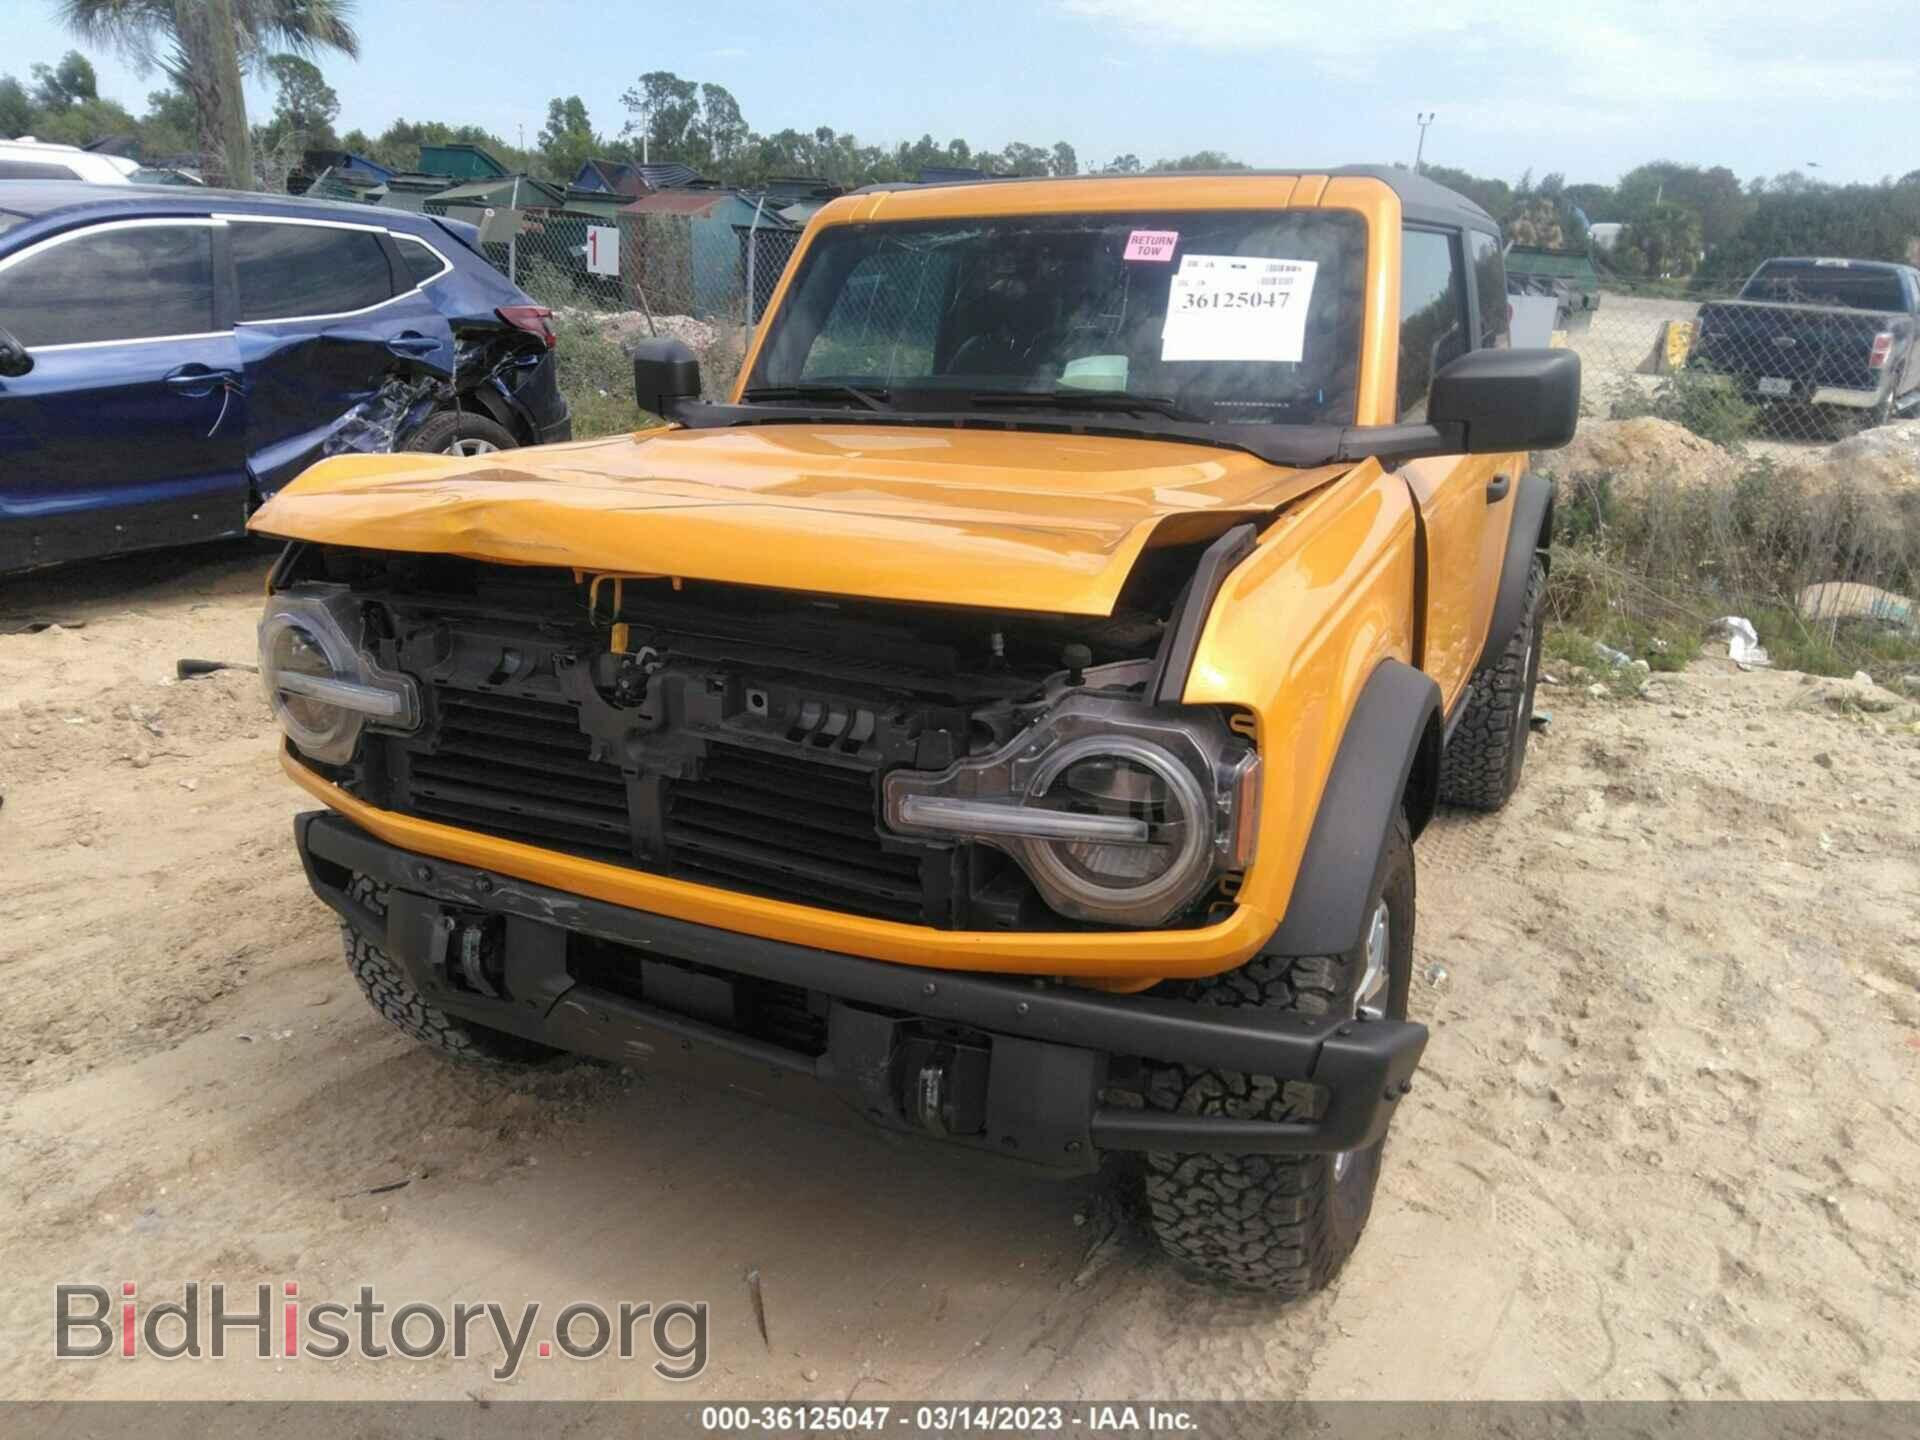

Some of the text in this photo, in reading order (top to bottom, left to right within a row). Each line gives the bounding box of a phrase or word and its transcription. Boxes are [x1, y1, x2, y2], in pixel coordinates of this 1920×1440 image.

[1130, 235, 1173, 246] RETURN
[589, 230, 597, 266] 1
[1137, 246, 1162, 256] TOW
[1182, 291, 1290, 309] 36125047
